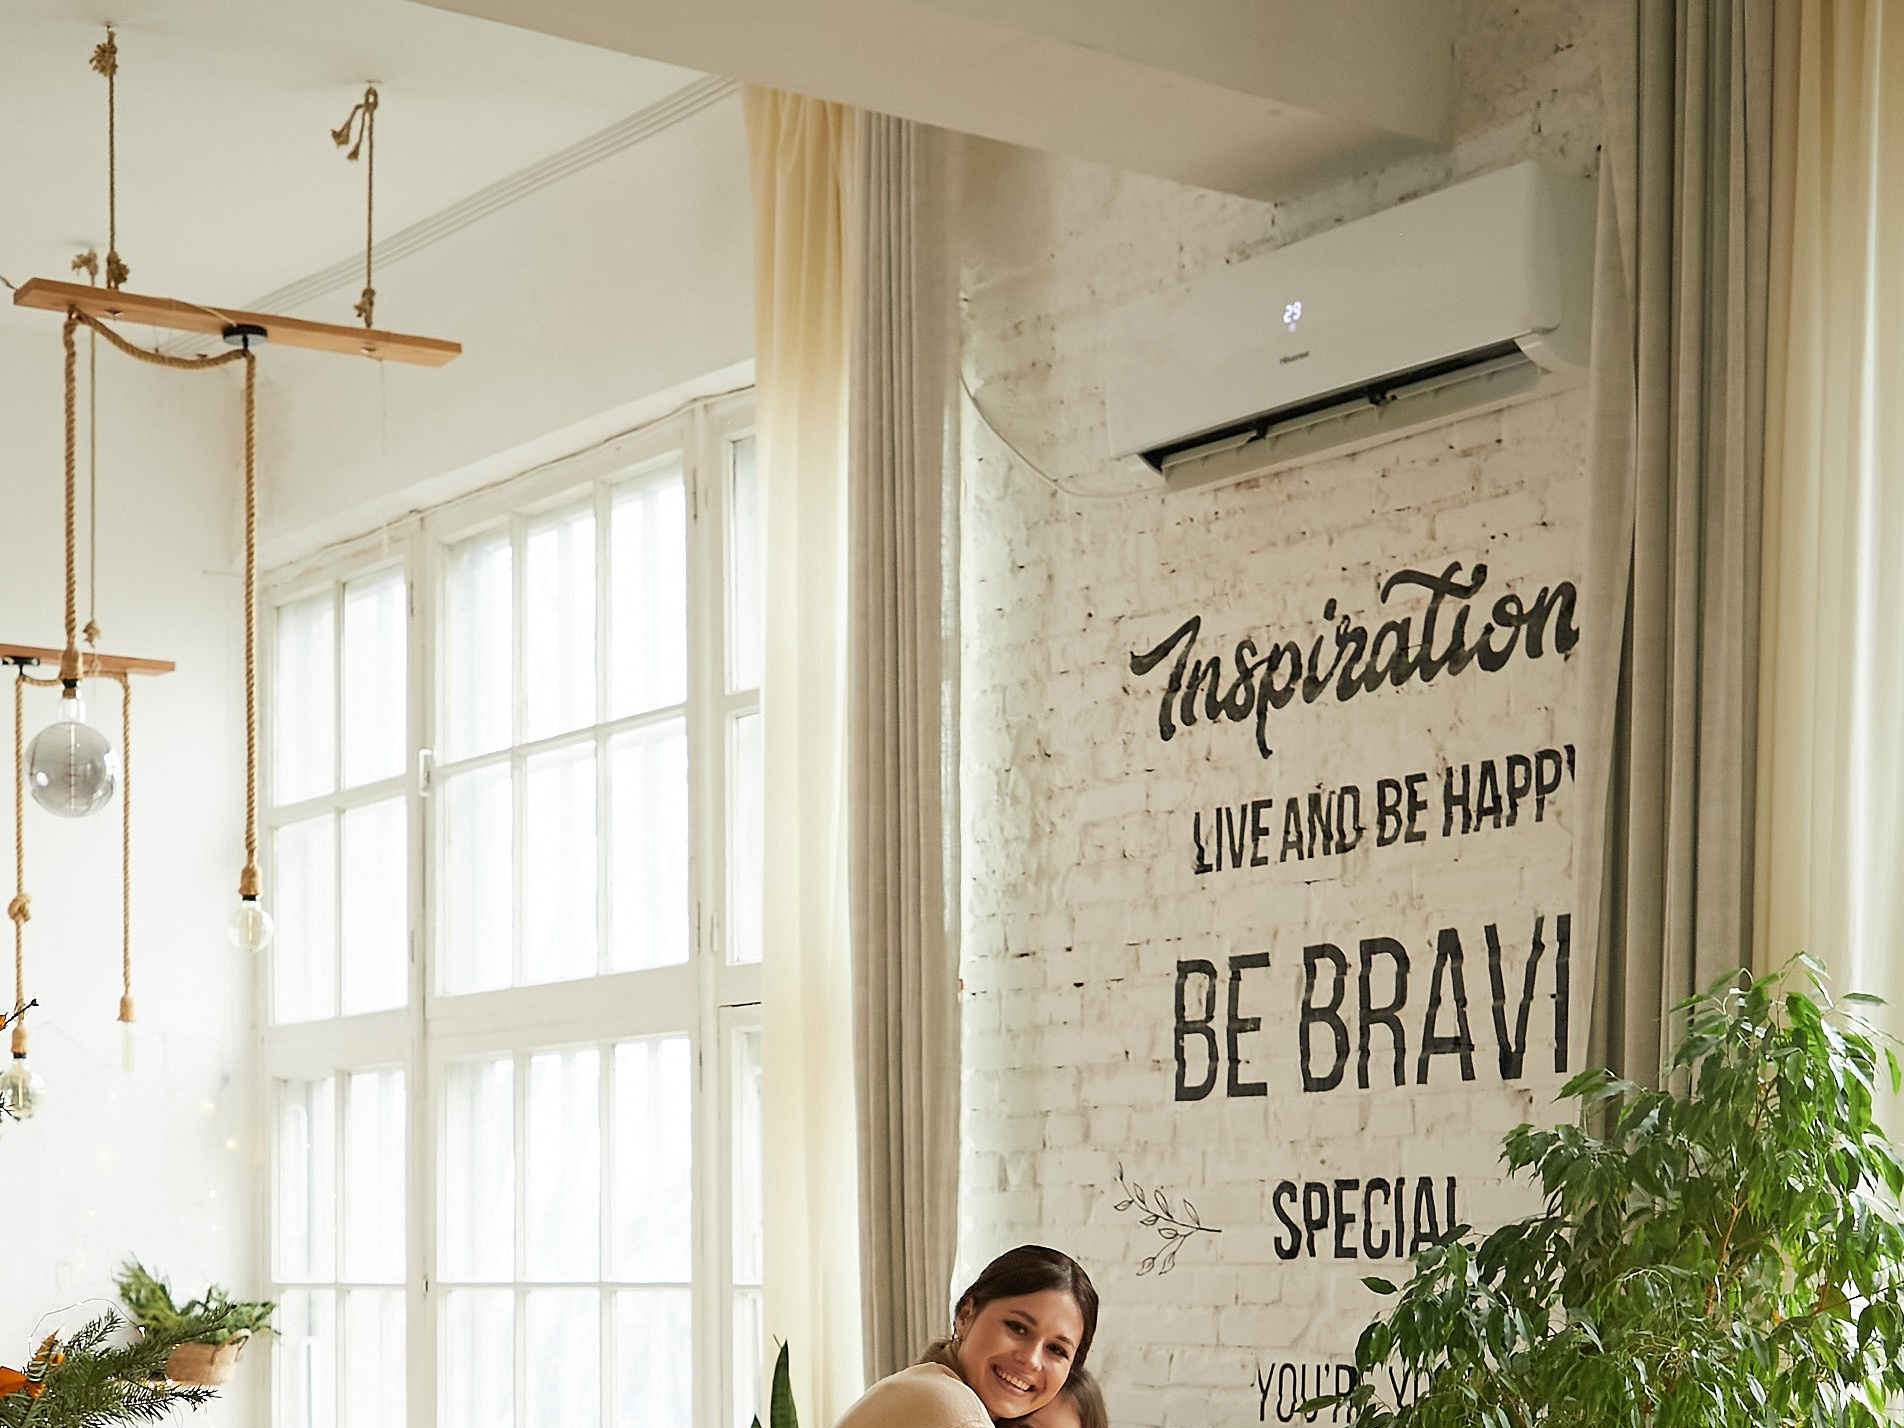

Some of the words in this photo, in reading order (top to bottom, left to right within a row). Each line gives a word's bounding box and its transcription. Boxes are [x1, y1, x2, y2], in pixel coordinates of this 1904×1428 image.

[1283, 301, 1303, 323] 29
[1129, 560, 1580, 759] Inspiration
[1193, 799, 1273, 875] LIVE
[1279, 785, 1367, 863] AND
[1376, 772, 1428, 848] BE
[1173, 951, 1271, 1102] BE
